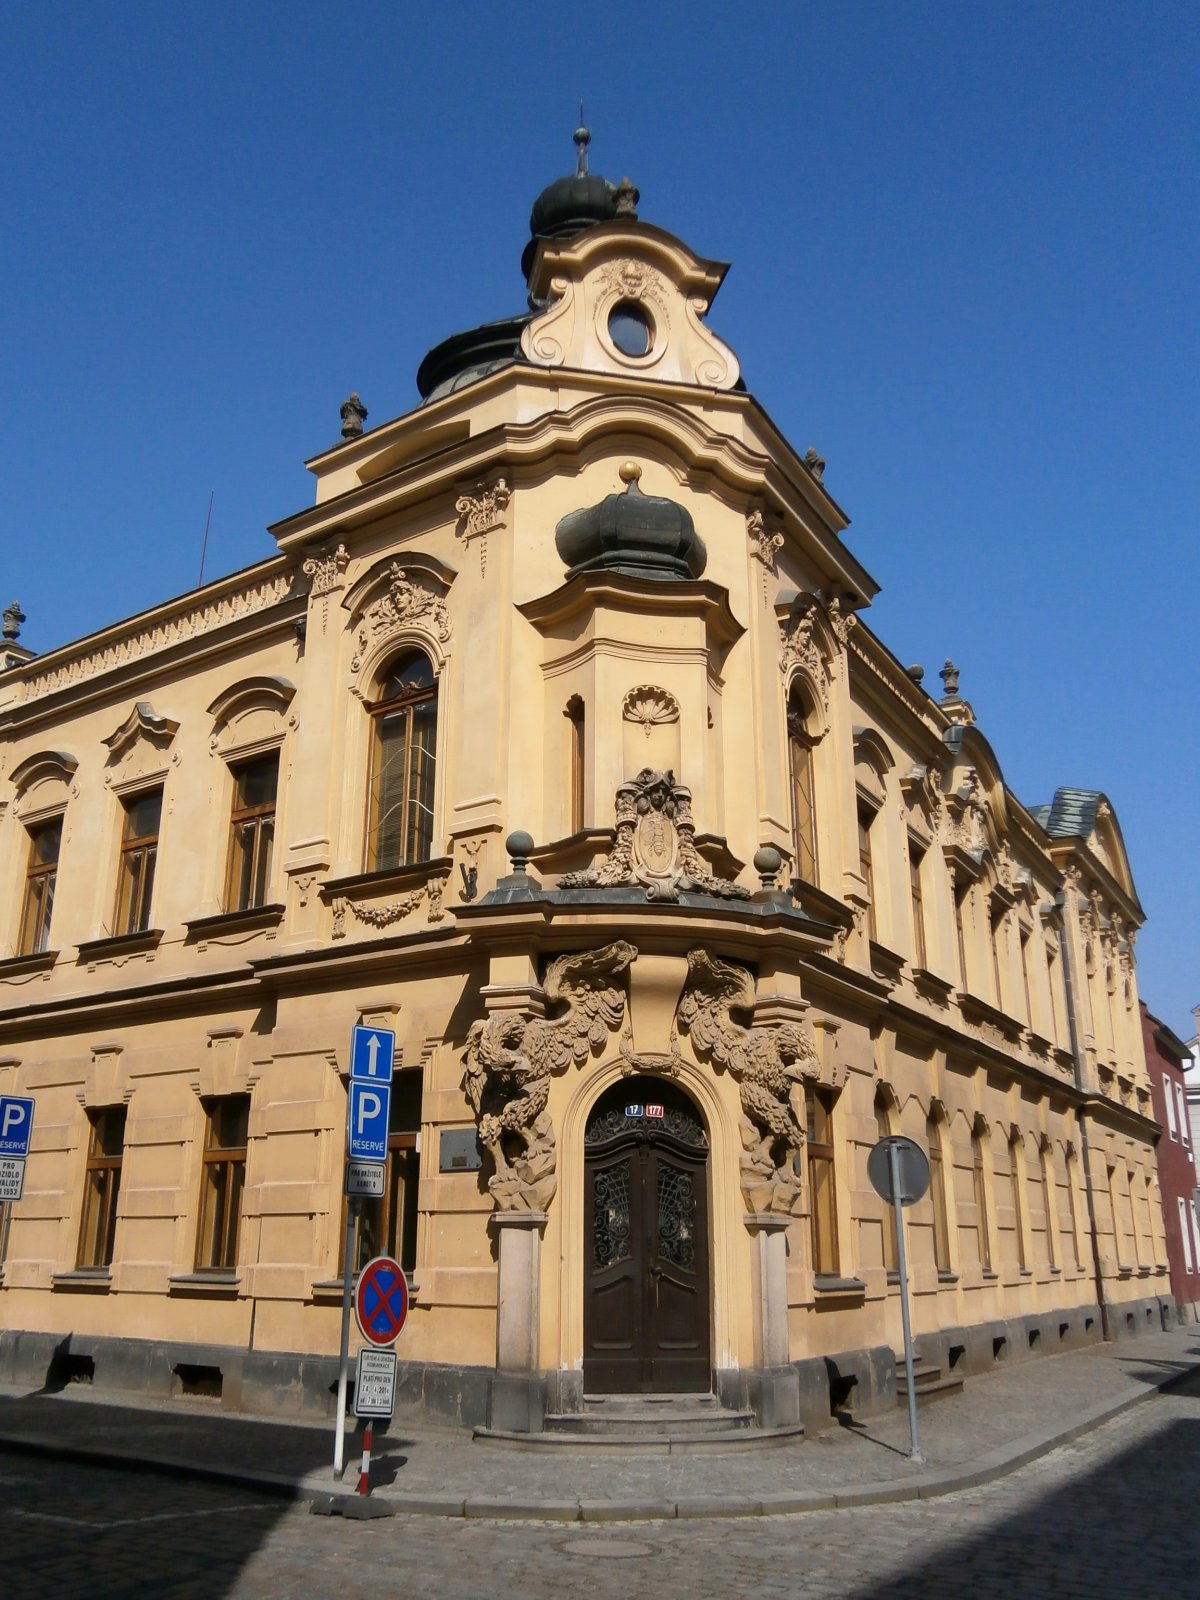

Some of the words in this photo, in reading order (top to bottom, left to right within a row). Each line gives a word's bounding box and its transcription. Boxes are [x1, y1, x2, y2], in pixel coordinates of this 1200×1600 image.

[357, 1091, 381, 1134] P
[630, 1104, 638, 1114] 17
[649, 1105, 661, 1115] 177
[1, 1103, 26, 1137] P
[0, 1140, 27, 1150] ÉSERVÉ
[352, 1138, 384, 1152] RÉSERVÉ
[2, 1162, 15, 1170] PRO
